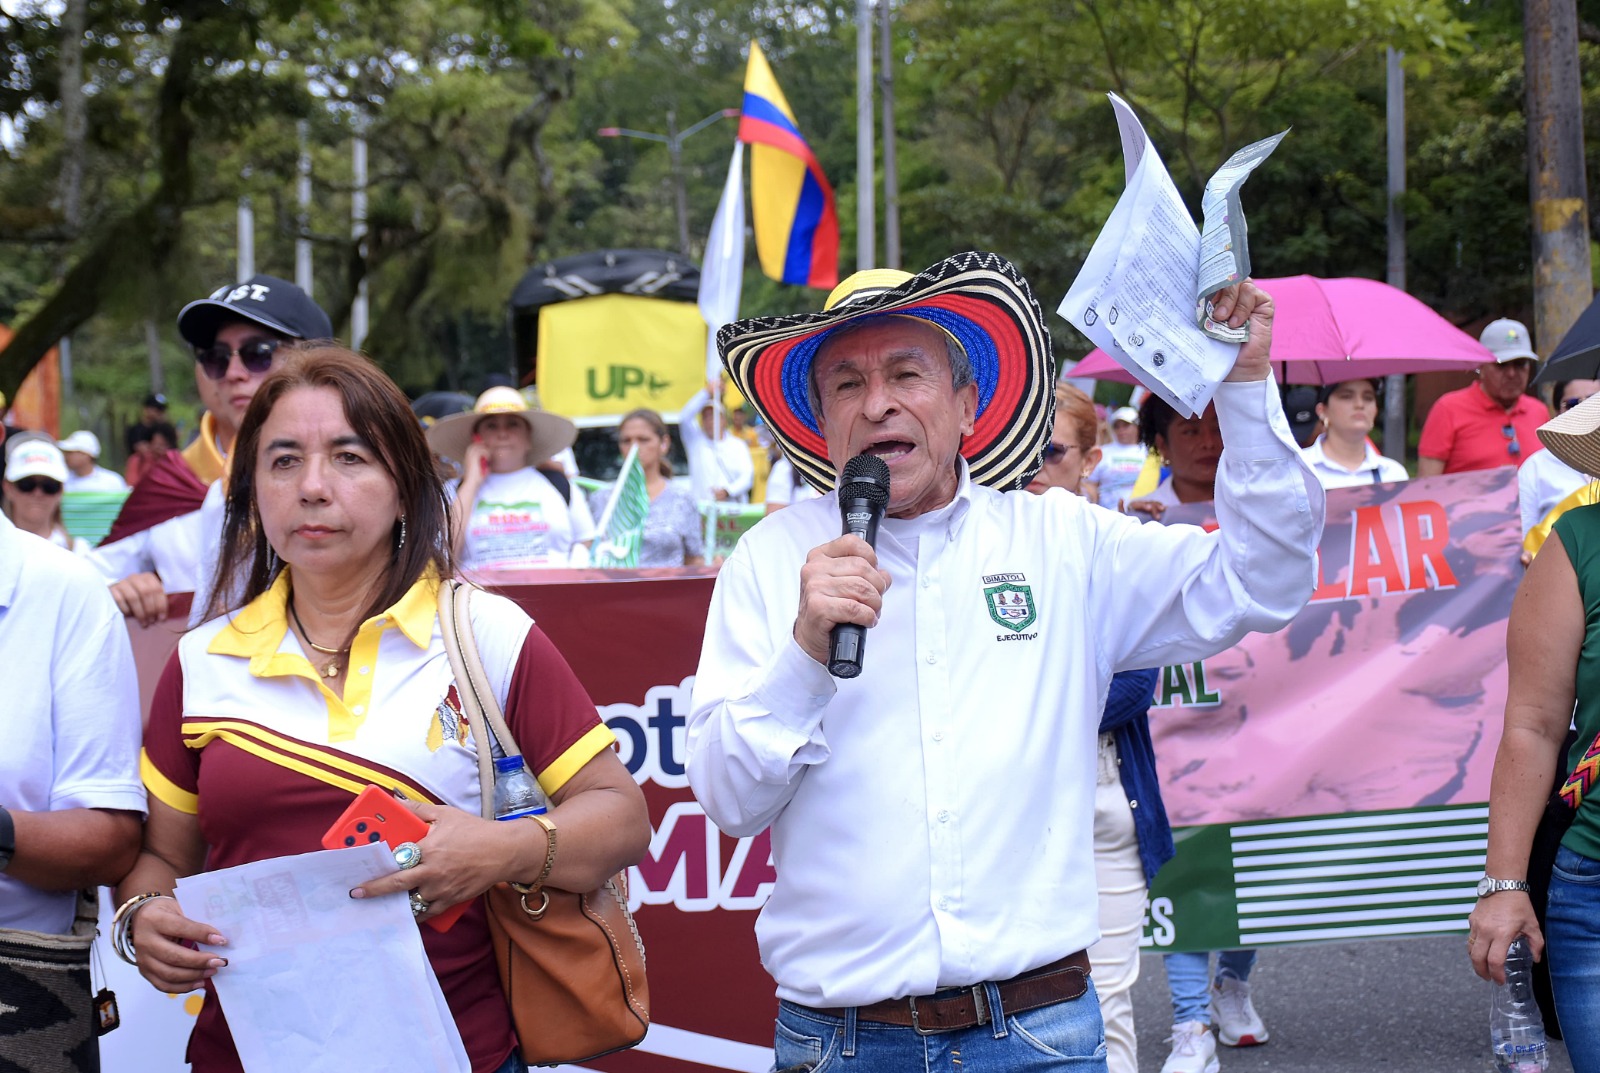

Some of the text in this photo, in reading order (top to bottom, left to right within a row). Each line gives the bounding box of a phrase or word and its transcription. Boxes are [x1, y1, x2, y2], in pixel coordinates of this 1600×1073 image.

[985, 574, 1022, 583] SIMATOL
[996, 632, 1038, 642] EJECUTIVO
[1152, 660, 1220, 706] AL
